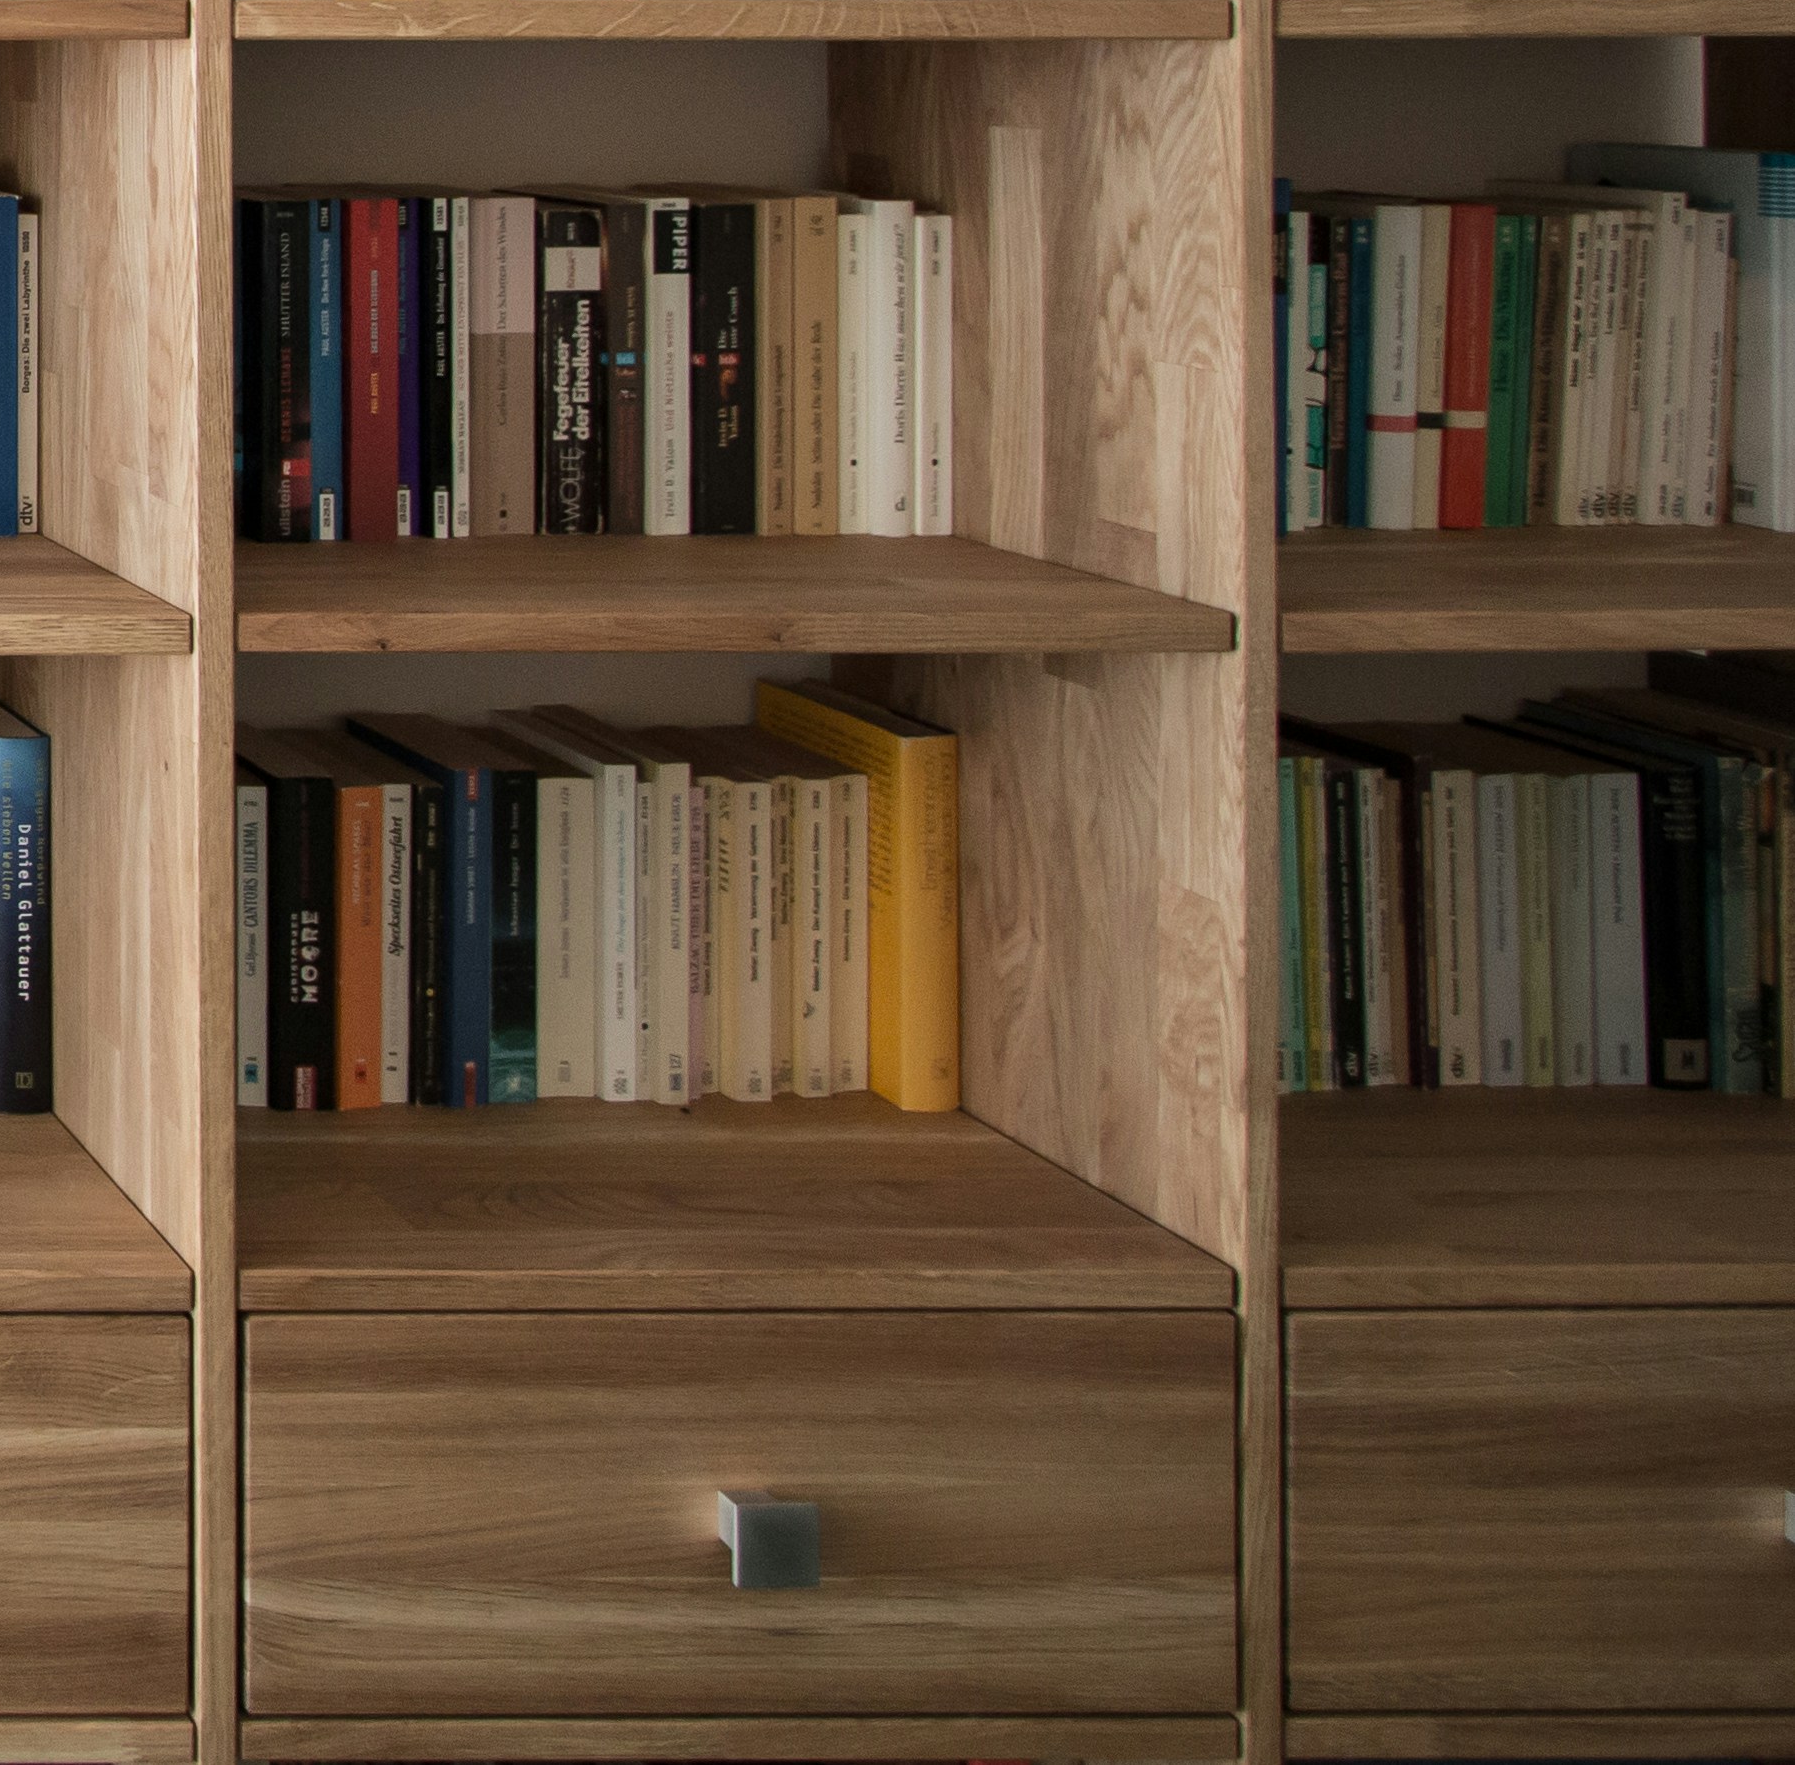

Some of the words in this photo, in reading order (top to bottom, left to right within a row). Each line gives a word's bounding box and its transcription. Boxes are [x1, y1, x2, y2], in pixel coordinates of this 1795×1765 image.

[554, 338, 571, 441] Fegefeuer
[571, 299, 591, 402] Eitelkeiten
[573, 404, 591, 440] der
